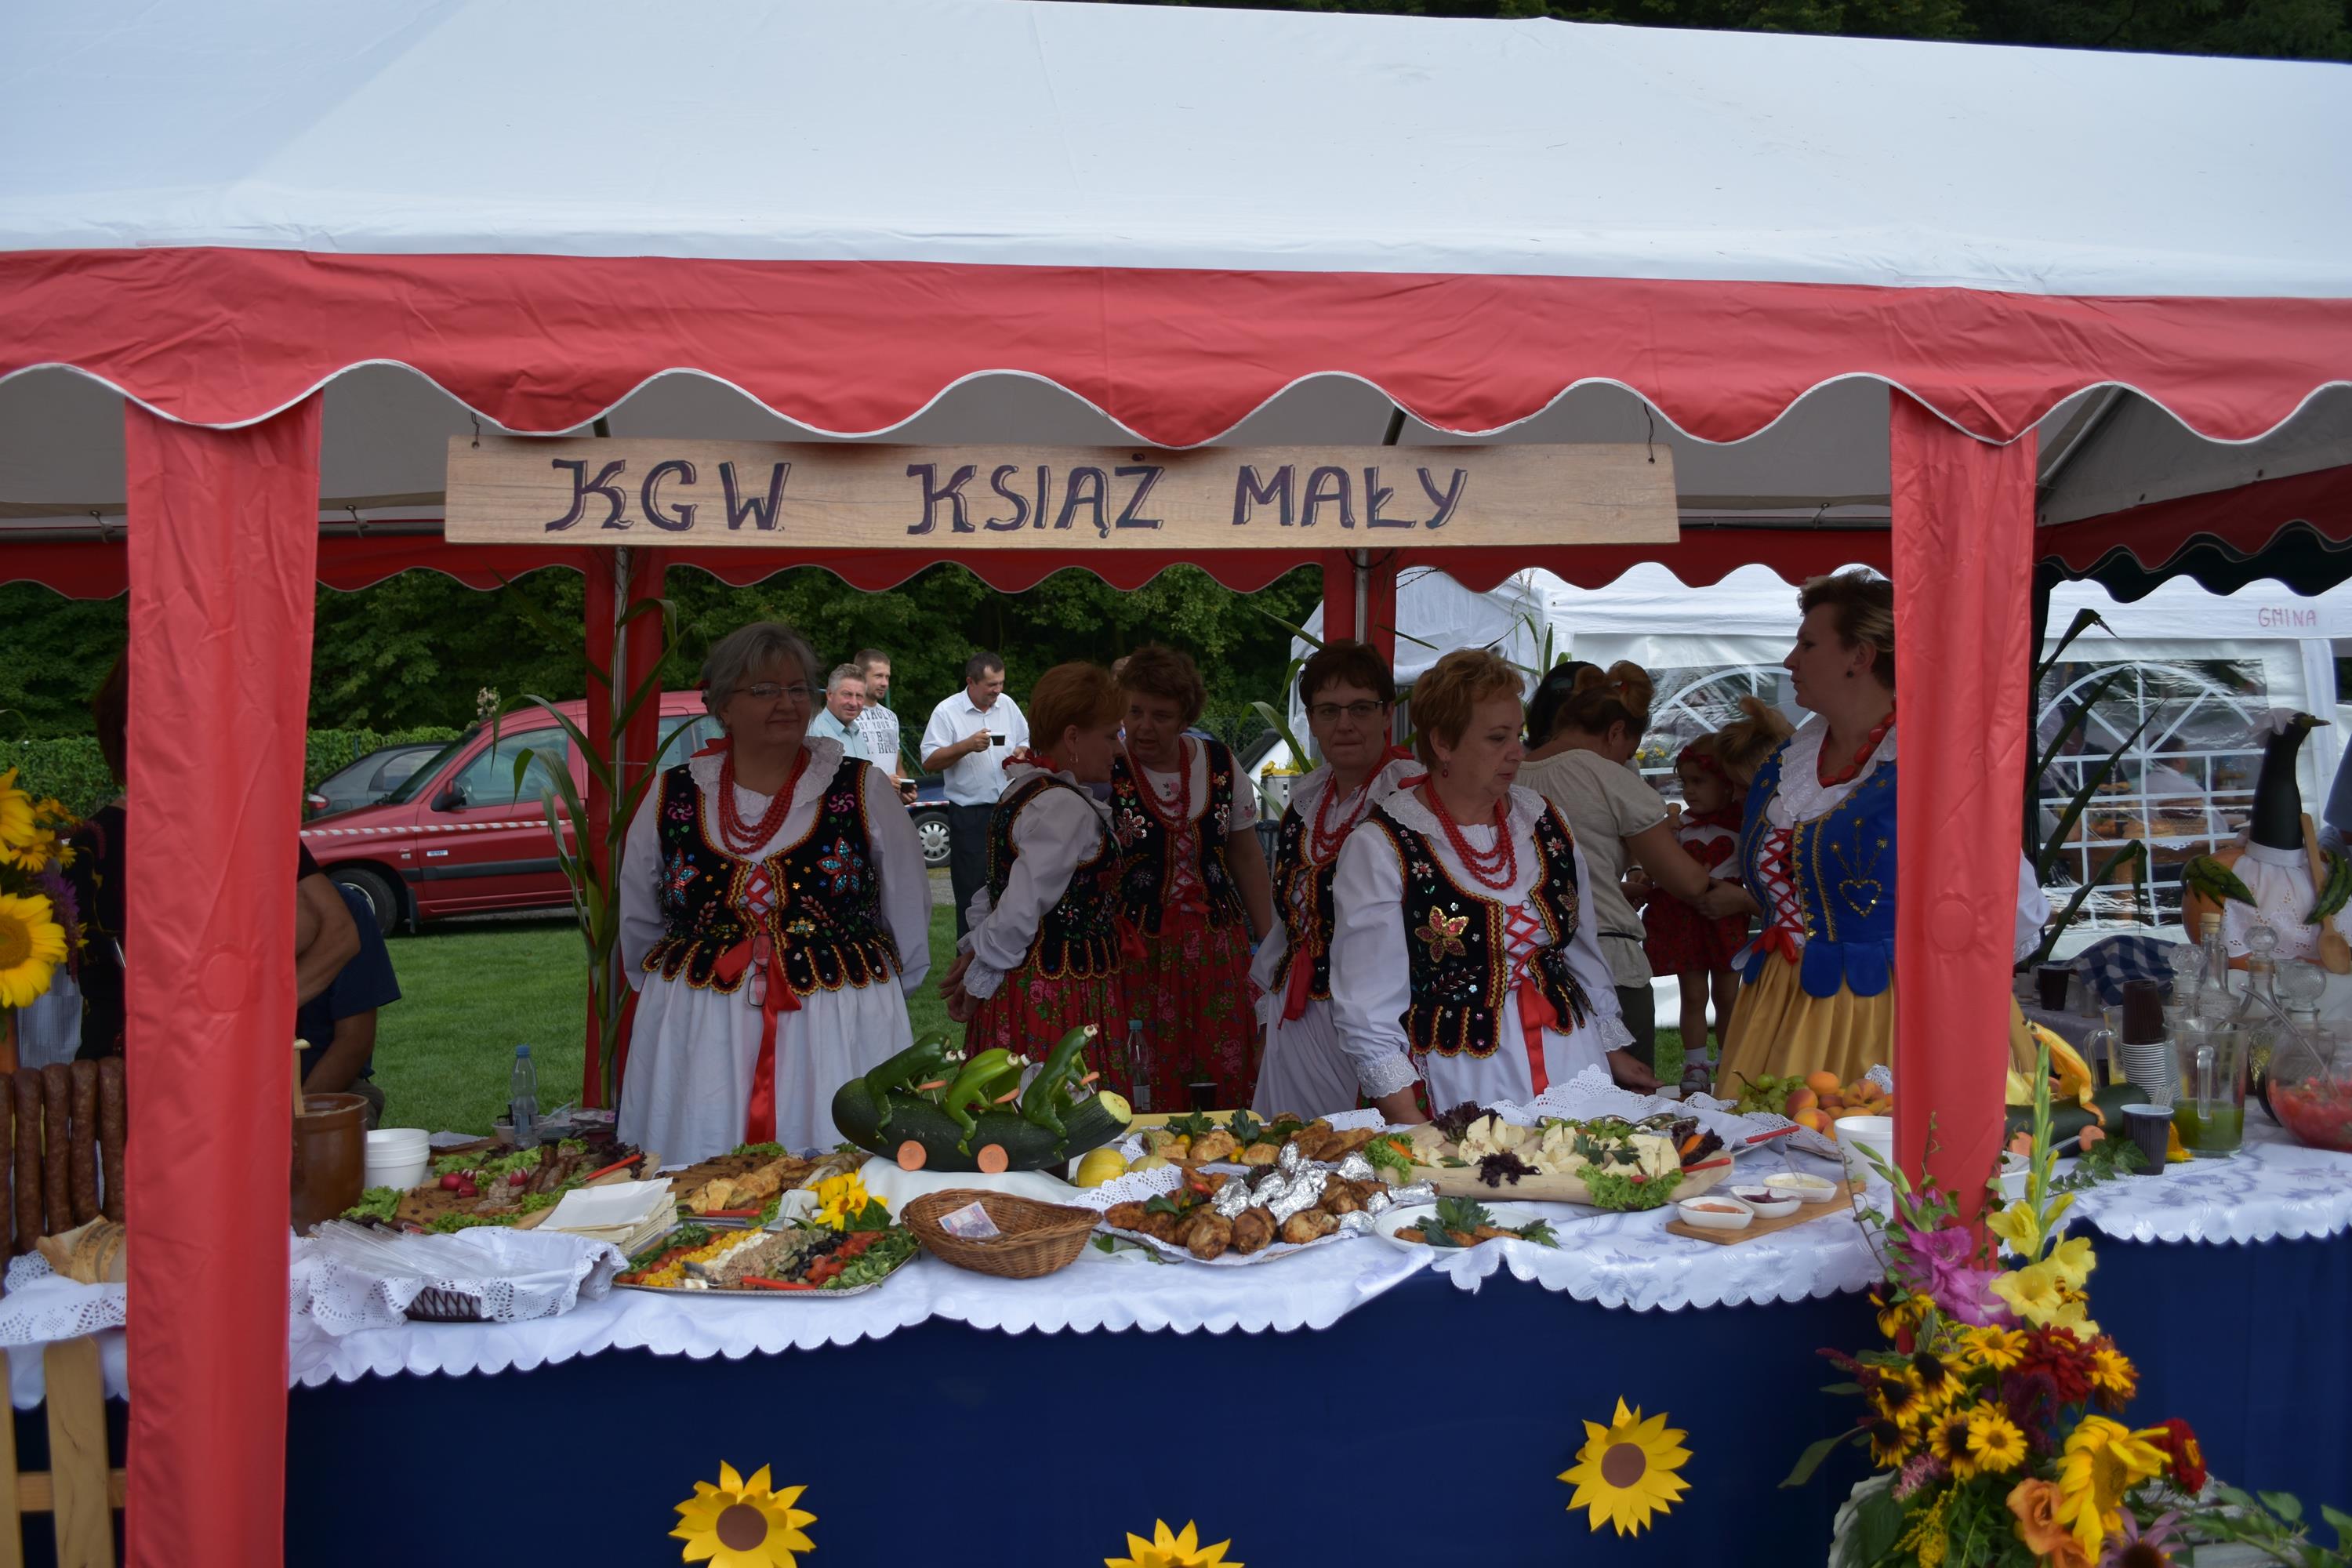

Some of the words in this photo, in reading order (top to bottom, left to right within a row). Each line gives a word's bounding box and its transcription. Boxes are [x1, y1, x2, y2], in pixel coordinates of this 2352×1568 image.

[545, 459, 791, 533] KGW
[906, 453, 1166, 539] KSIĄŻ
[1232, 464, 1468, 530] MAŁY
[2258, 607, 2318, 627] GMINA
